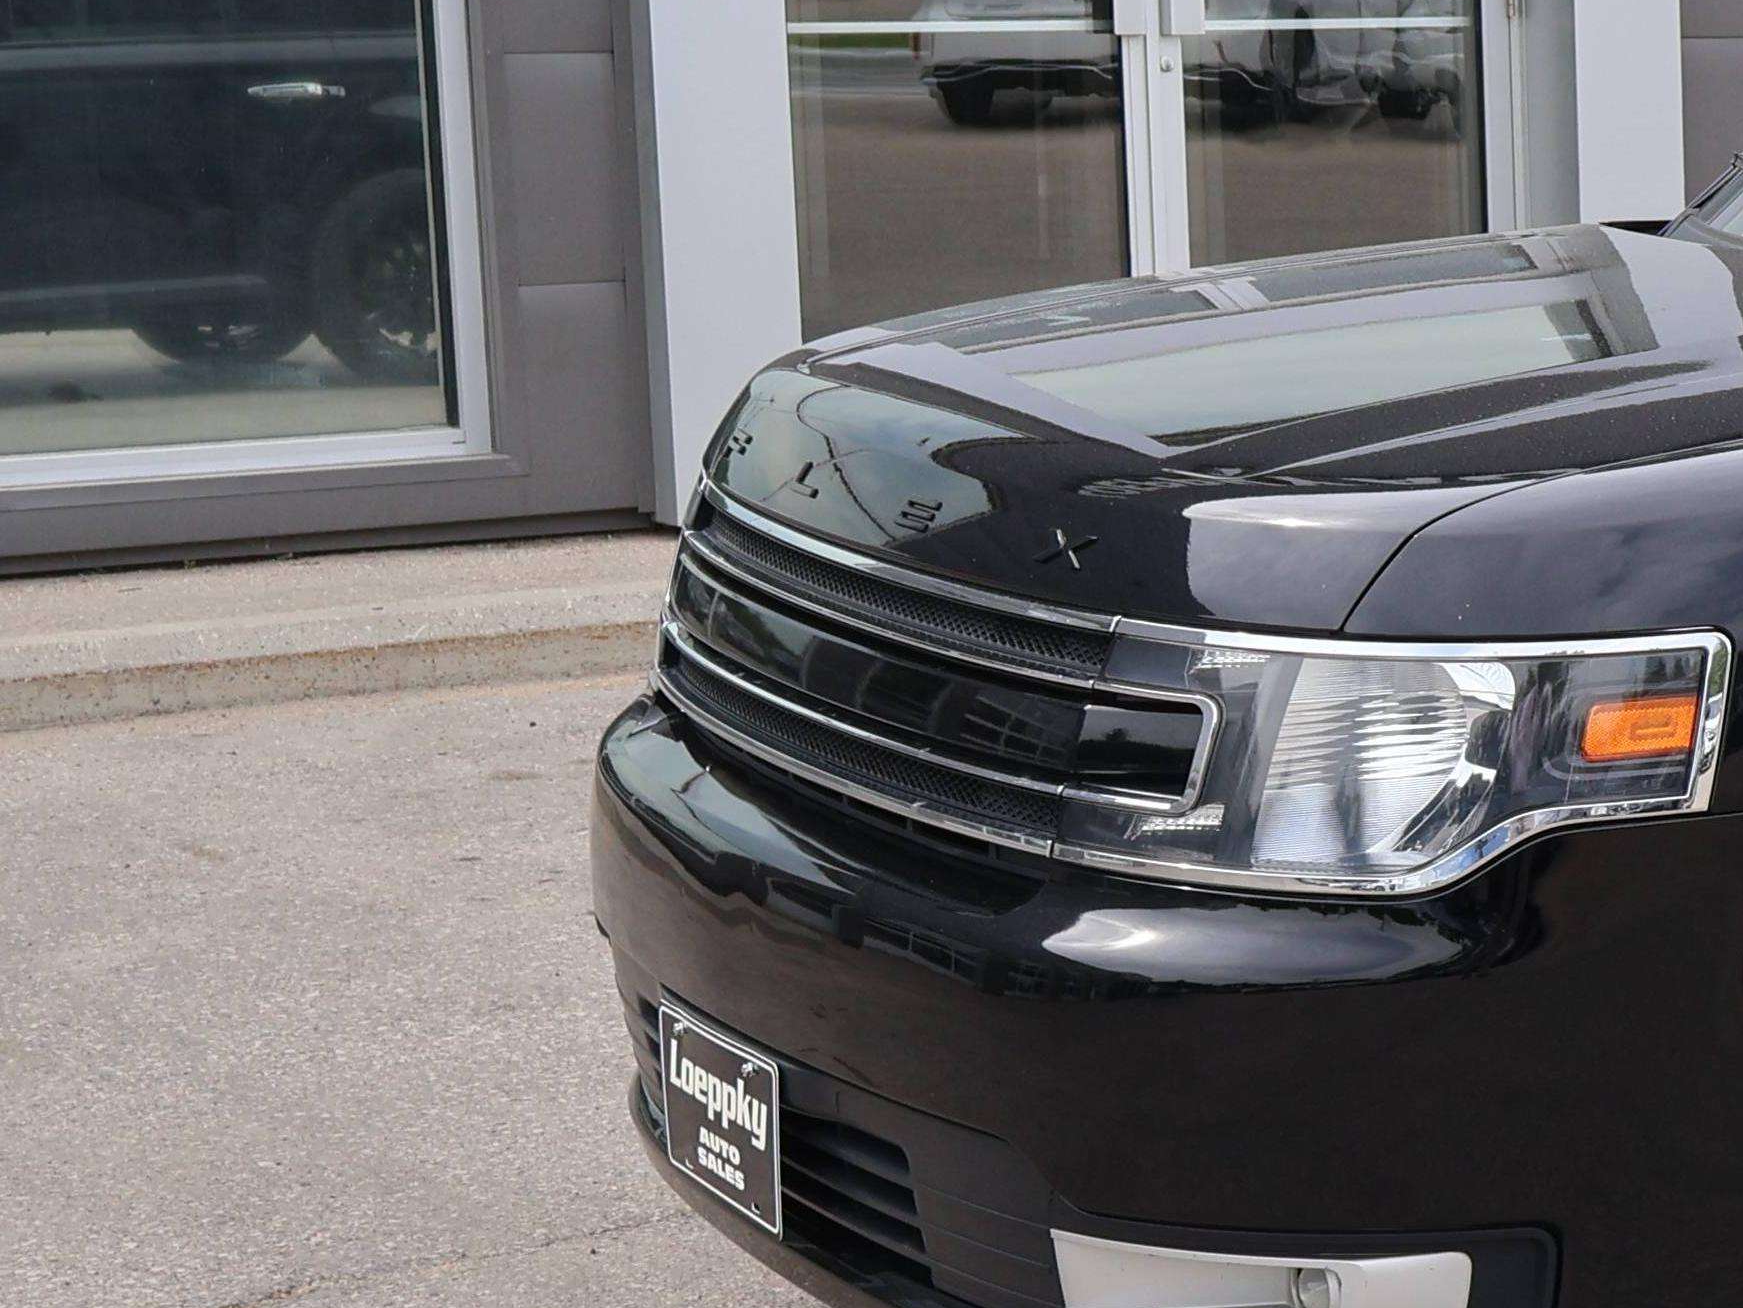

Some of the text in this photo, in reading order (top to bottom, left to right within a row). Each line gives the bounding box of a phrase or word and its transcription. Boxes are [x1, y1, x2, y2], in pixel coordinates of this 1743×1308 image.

[669, 1038, 767, 1152] Loeppky
[699, 1125, 741, 1166] AUTO
[697, 1146, 745, 1191] SALES
